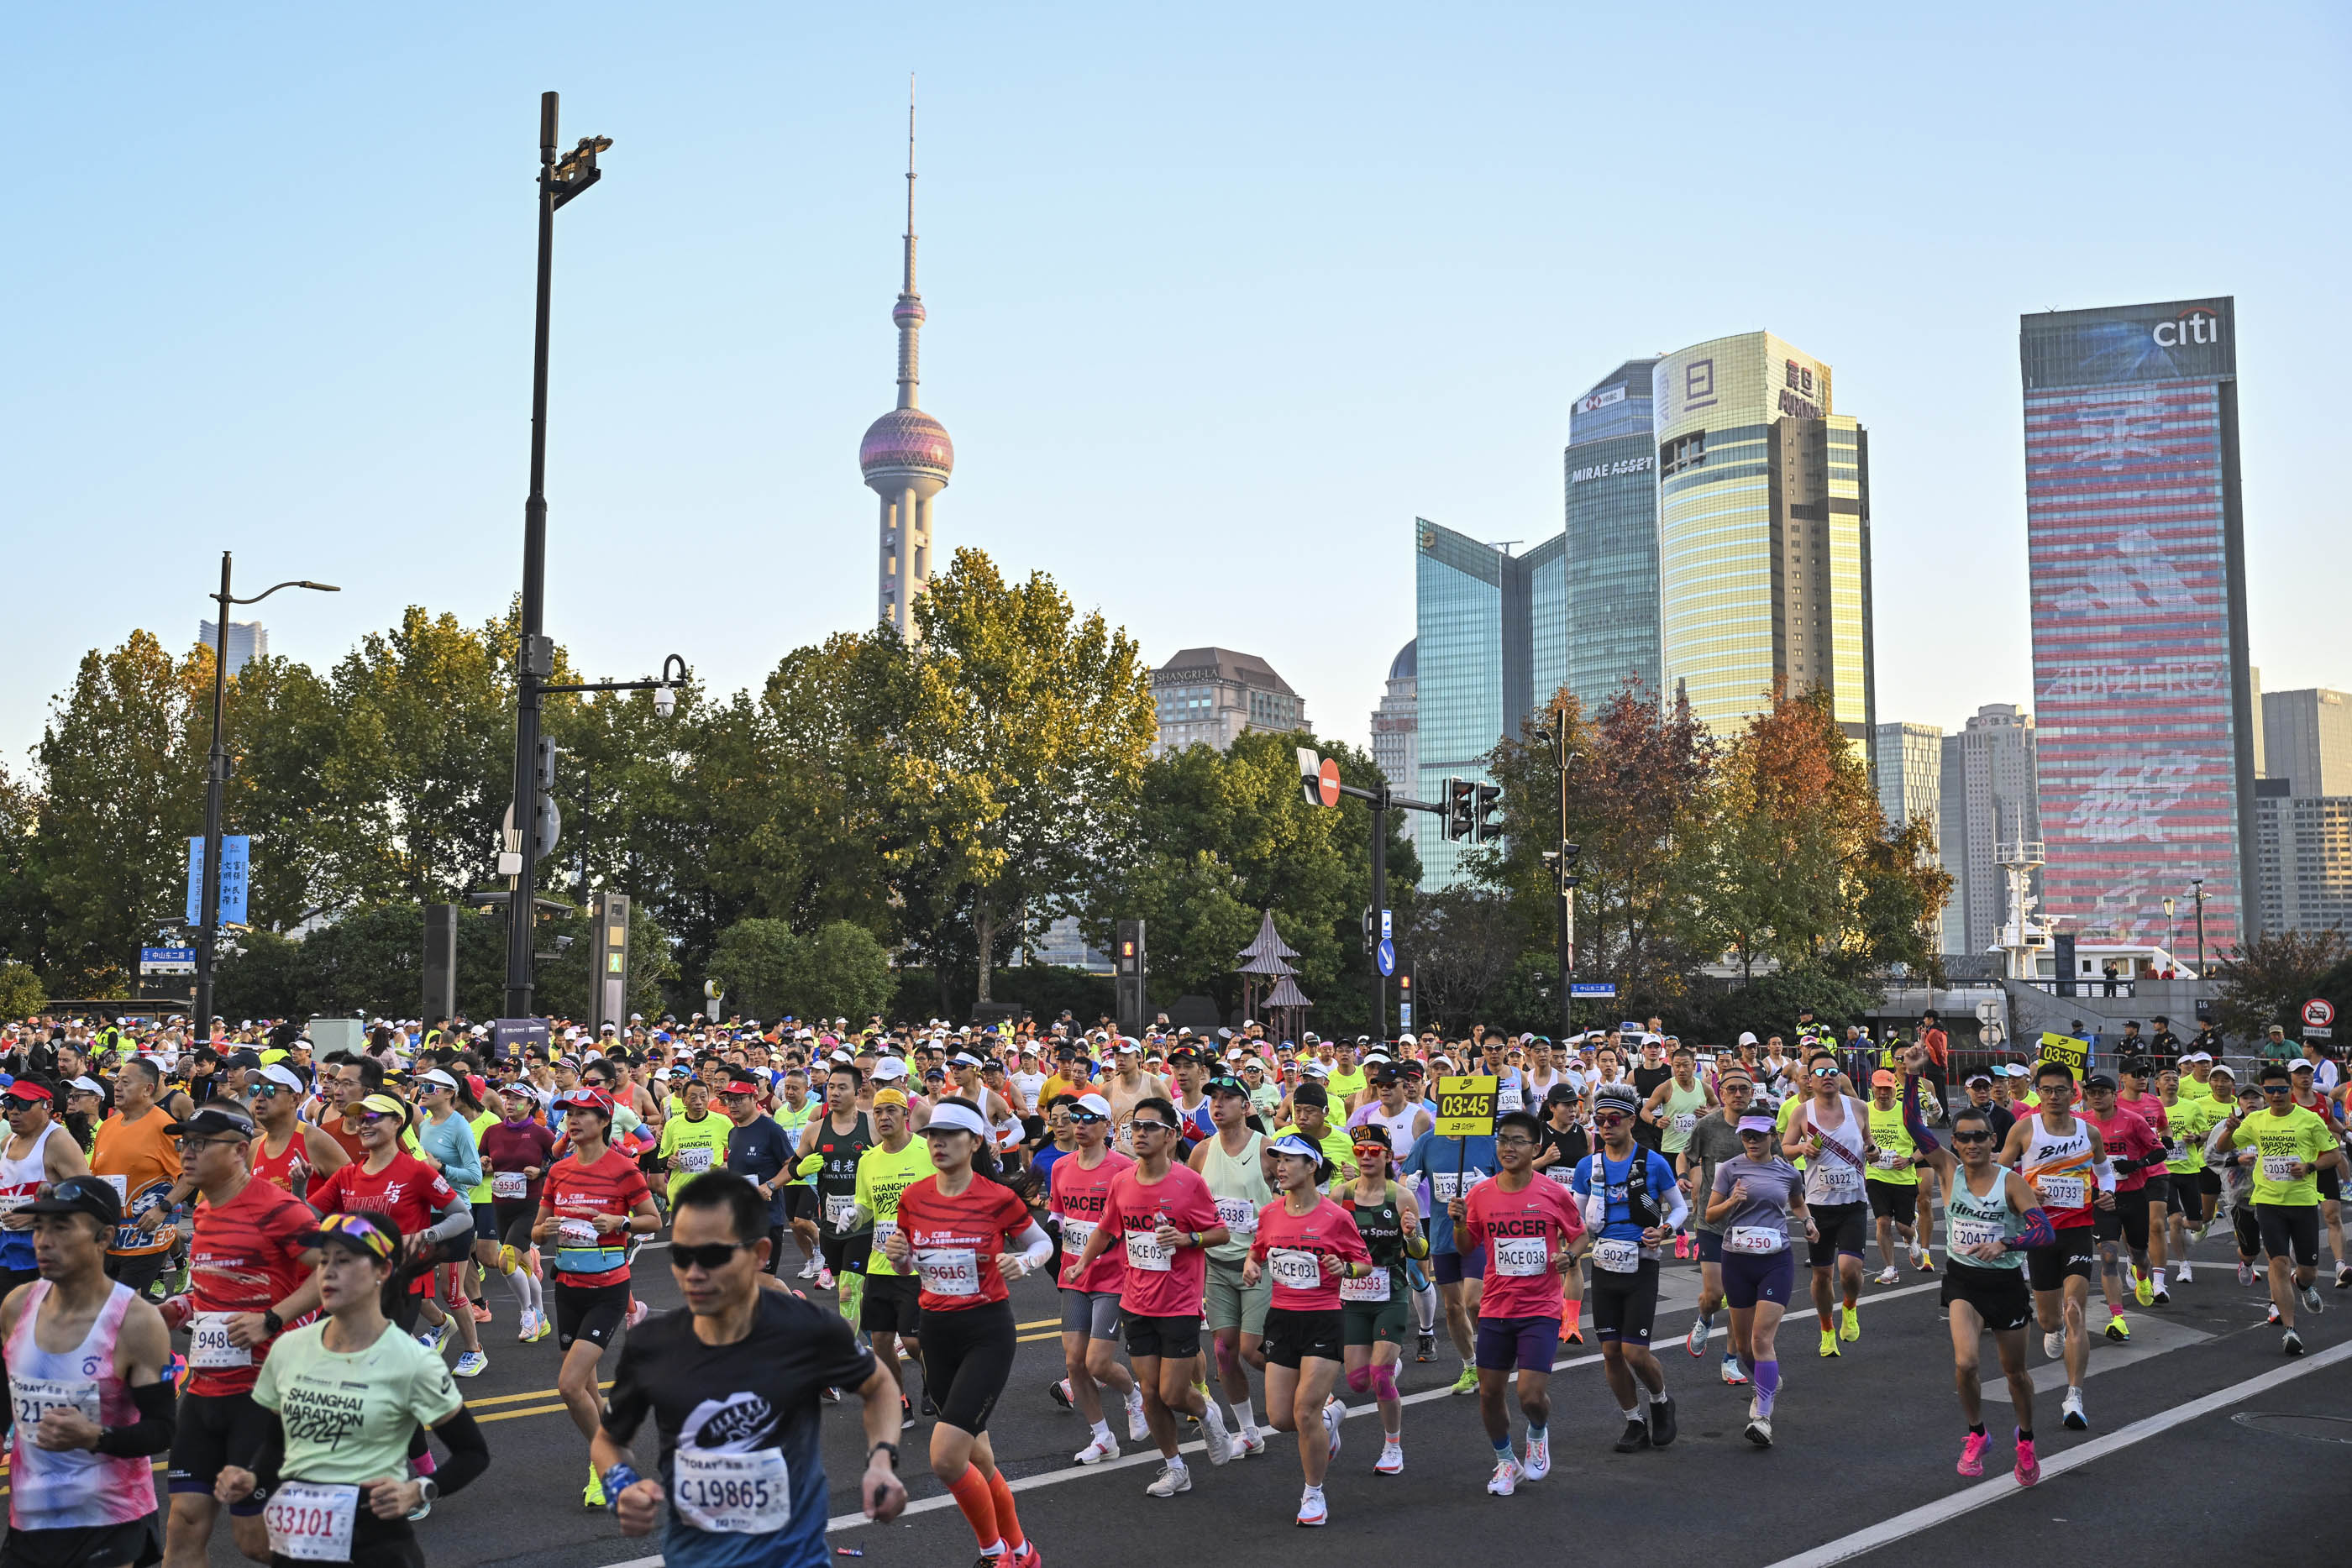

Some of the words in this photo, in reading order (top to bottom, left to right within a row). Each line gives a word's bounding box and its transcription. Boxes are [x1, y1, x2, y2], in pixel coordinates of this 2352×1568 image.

[2153, 312, 2218, 347] citi
[1603, 391, 1618, 403] HSBC
[1572, 463, 1609, 484] MIRAE
[1611, 456, 1654, 475] ASSET
[152, 952, 185, 960] 中山东二路
[2044, 1046, 2081, 1067] 03:30
[1442, 1095, 1489, 1116] 03:45
[678, 1141, 712, 1149] SHANGHAI
[2264, 1164, 2291, 1173] C2032
[499, 1181, 521, 1190] 9530
[1370, 1228, 1398, 1237] Speed
[1487, 1220, 1546, 1236] PACER
[1063, 1230, 1081, 1245] PACE
[1746, 1237, 1771, 1248] 250
[1128, 1243, 1148, 1259] PACE
[1498, 1251, 1525, 1265] PACE
[1526, 1251, 1545, 1265] 038
[1604, 1249, 1630, 1261] 9027
[929, 1265, 967, 1280] 9616
[1272, 1260, 1296, 1277] PACE
[1298, 1264, 1318, 1278] 031
[287, 1387, 364, 1412] SHANGHAI
[283, 1402, 364, 1427] MARATHON
[286, 1416, 353, 1451] 2024
[680, 1479, 769, 1508] C19865
[266, 1504, 333, 1537] C33101
